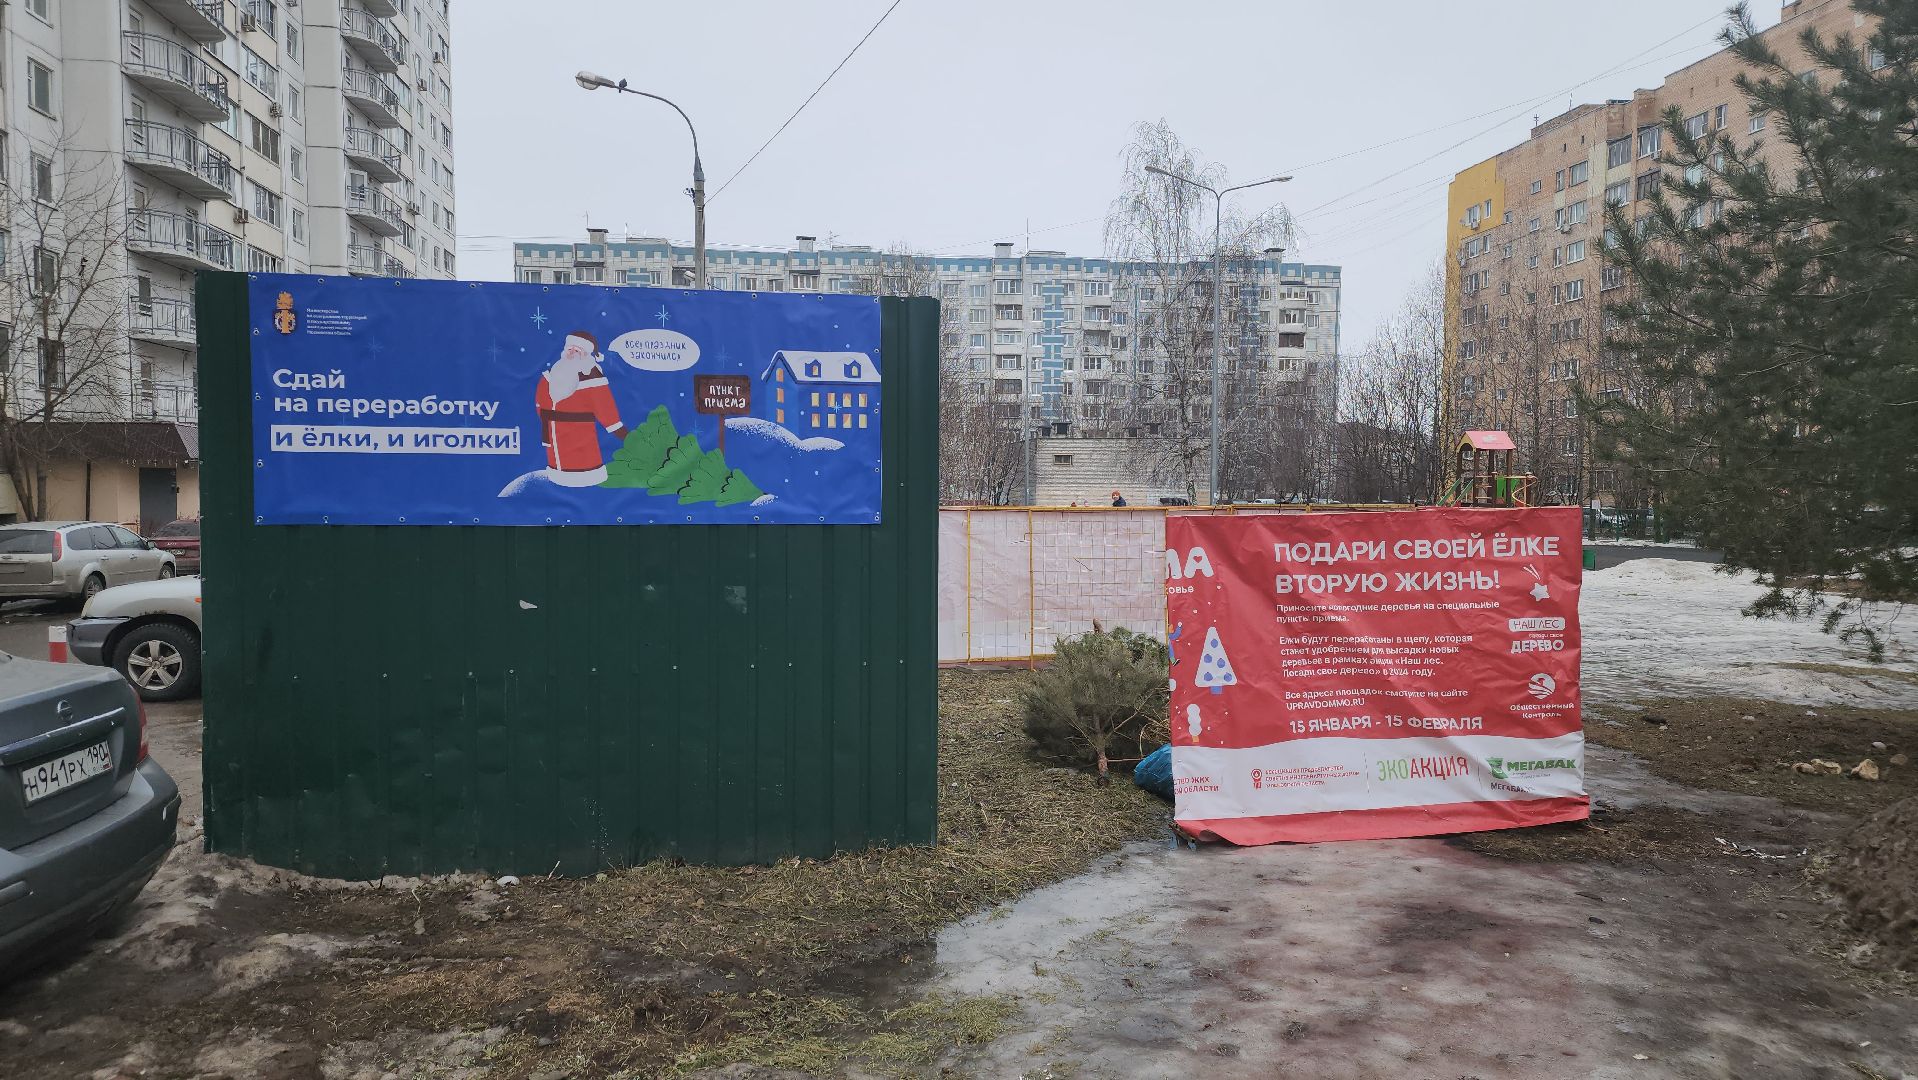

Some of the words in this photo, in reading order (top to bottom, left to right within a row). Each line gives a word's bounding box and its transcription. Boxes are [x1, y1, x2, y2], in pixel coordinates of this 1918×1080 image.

[645, 341, 687, 350] ПРАЗДНИК
[272, 368, 345, 391] Сдай
[709, 384, 741, 396] ПУНКТ
[274, 397, 308, 412] на
[317, 394, 500, 421] переработку
[704, 397, 746, 410] ПРИЕМА
[275, 431, 293, 447] и
[302, 427, 379, 451] ёлки,
[387, 433, 404, 448] и
[414, 431, 518, 449] иголки!
[1274, 540, 1386, 566] ПОДАРИ
[1393, 532, 1486, 560] СВОЕЙ
[1493, 532, 1560, 557] ЁЛКЕ
[1275, 572, 1388, 595] ВТОРУЮ
[1394, 570, 1500, 592] ЖИЗНЬ!
[1276, 604, 1327, 613] Приносите
[1380, 603, 1421, 612] деревья
[1436, 601, 1500, 611] специальные
[1276, 615, 1309, 624] пункты
[1513, 619, 1537, 630] НАШ
[1538, 618, 1560, 629] ЛЕС
[1301, 635, 1330, 645] будут
[1331, 635, 1394, 645] переработаны
[1396, 636, 1403, 644] в
[1403, 636, 1433, 646] щепу,
[1434, 635, 1473, 645] которая
[1510, 639, 1565, 654] ДЕРЕВО
[1280, 647, 1309, 656] станет
[1311, 645, 1370, 656] удобрением
[1385, 646, 1427, 655] высадки
[1429, 646, 1460, 654] новых
[1282, 658, 1323, 668] деревьев
[1332, 656, 1368, 666] рамках
[1395, 656, 1421, 665] «Наш
[1283, 668, 1315, 677] Посади
[1339, 667, 1381, 676] дерево»
[1411, 668, 1436, 678] году.
[1285, 691, 1301, 700] Все
[1302, 689, 1334, 700] адреса
[1335, 688, 1383, 697] площадок
[1427, 690, 1439, 698] на
[1440, 688, 1469, 698] сайте
[1286, 697, 1365, 711] UPRAVDOMMO.RU
[1289, 719, 1306, 734] 15
[1308, 714, 1372, 733] ЯНВАРЯ
[1384, 714, 1403, 728] 15
[1407, 715, 1483, 730] ФЕВРАЛЯ
[1376, 756, 1470, 781] ЭКОАКЦИЯ
[1507, 759, 1576, 772] МЕГАБАК
[1183, 785, 1219, 794] ОБЛАСТИ
